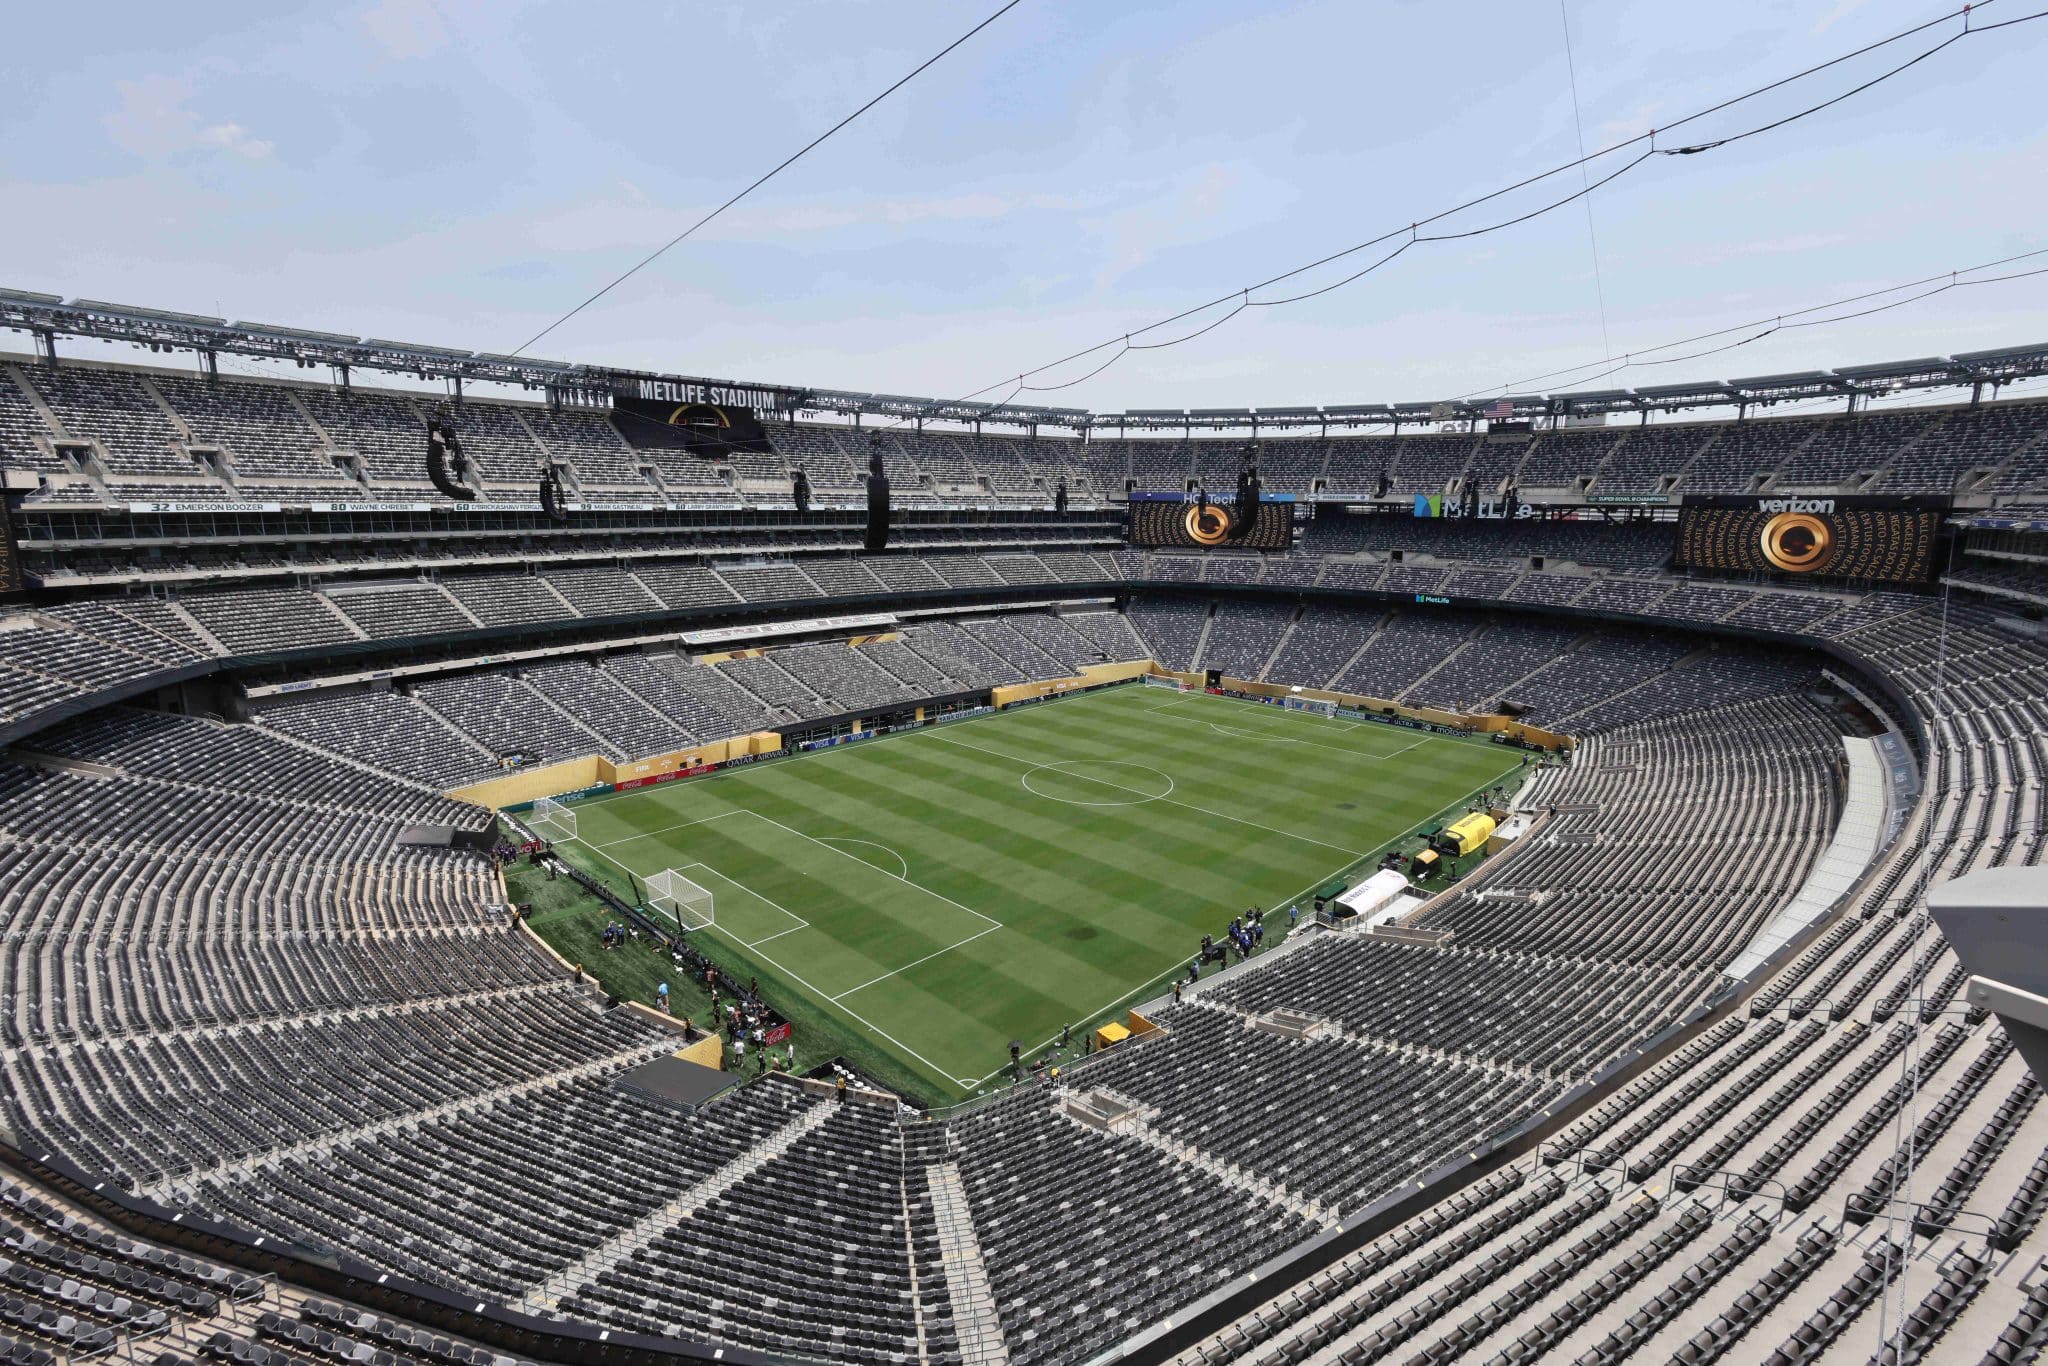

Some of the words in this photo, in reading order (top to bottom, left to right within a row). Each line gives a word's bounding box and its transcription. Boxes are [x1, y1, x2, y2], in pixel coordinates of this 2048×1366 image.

[640, 379, 706, 404] METLIFE
[710, 386, 775, 410] STADIUM
[1183, 493, 1237, 505] HCTech
[151, 503, 170, 512] 32
[175, 503, 225, 511] EMERSON
[226, 503, 264, 511] BOOZER
[330, 503, 346, 511] 80
[350, 503, 380, 511] WAYNE
[380, 503, 415, 511] CHREBET
[456, 503, 469, 511] 60
[580, 503, 592, 511] 99
[593, 503, 611, 511] MARK
[1759, 495, 1835, 514] verizon
[1845, 511, 1860, 550] GERMAIN
[1889, 514, 1900, 550] REGATAS
[1902, 515, 1914, 552] ANGELES
[1916, 535, 1928, 557] CLUB
[1425, 596, 1450, 604] MetLife
[1336, 709, 1358, 718] MERICA
[1394, 719, 1414, 728] ULTRA
[850, 732, 865, 742] VISA
[813, 739, 830, 749] VISA
[726, 756, 755, 768] QATAR
[757, 749, 790, 762] AIRWAYS
[635, 765, 650, 773] FIFA
[557, 790, 585, 804] ense
